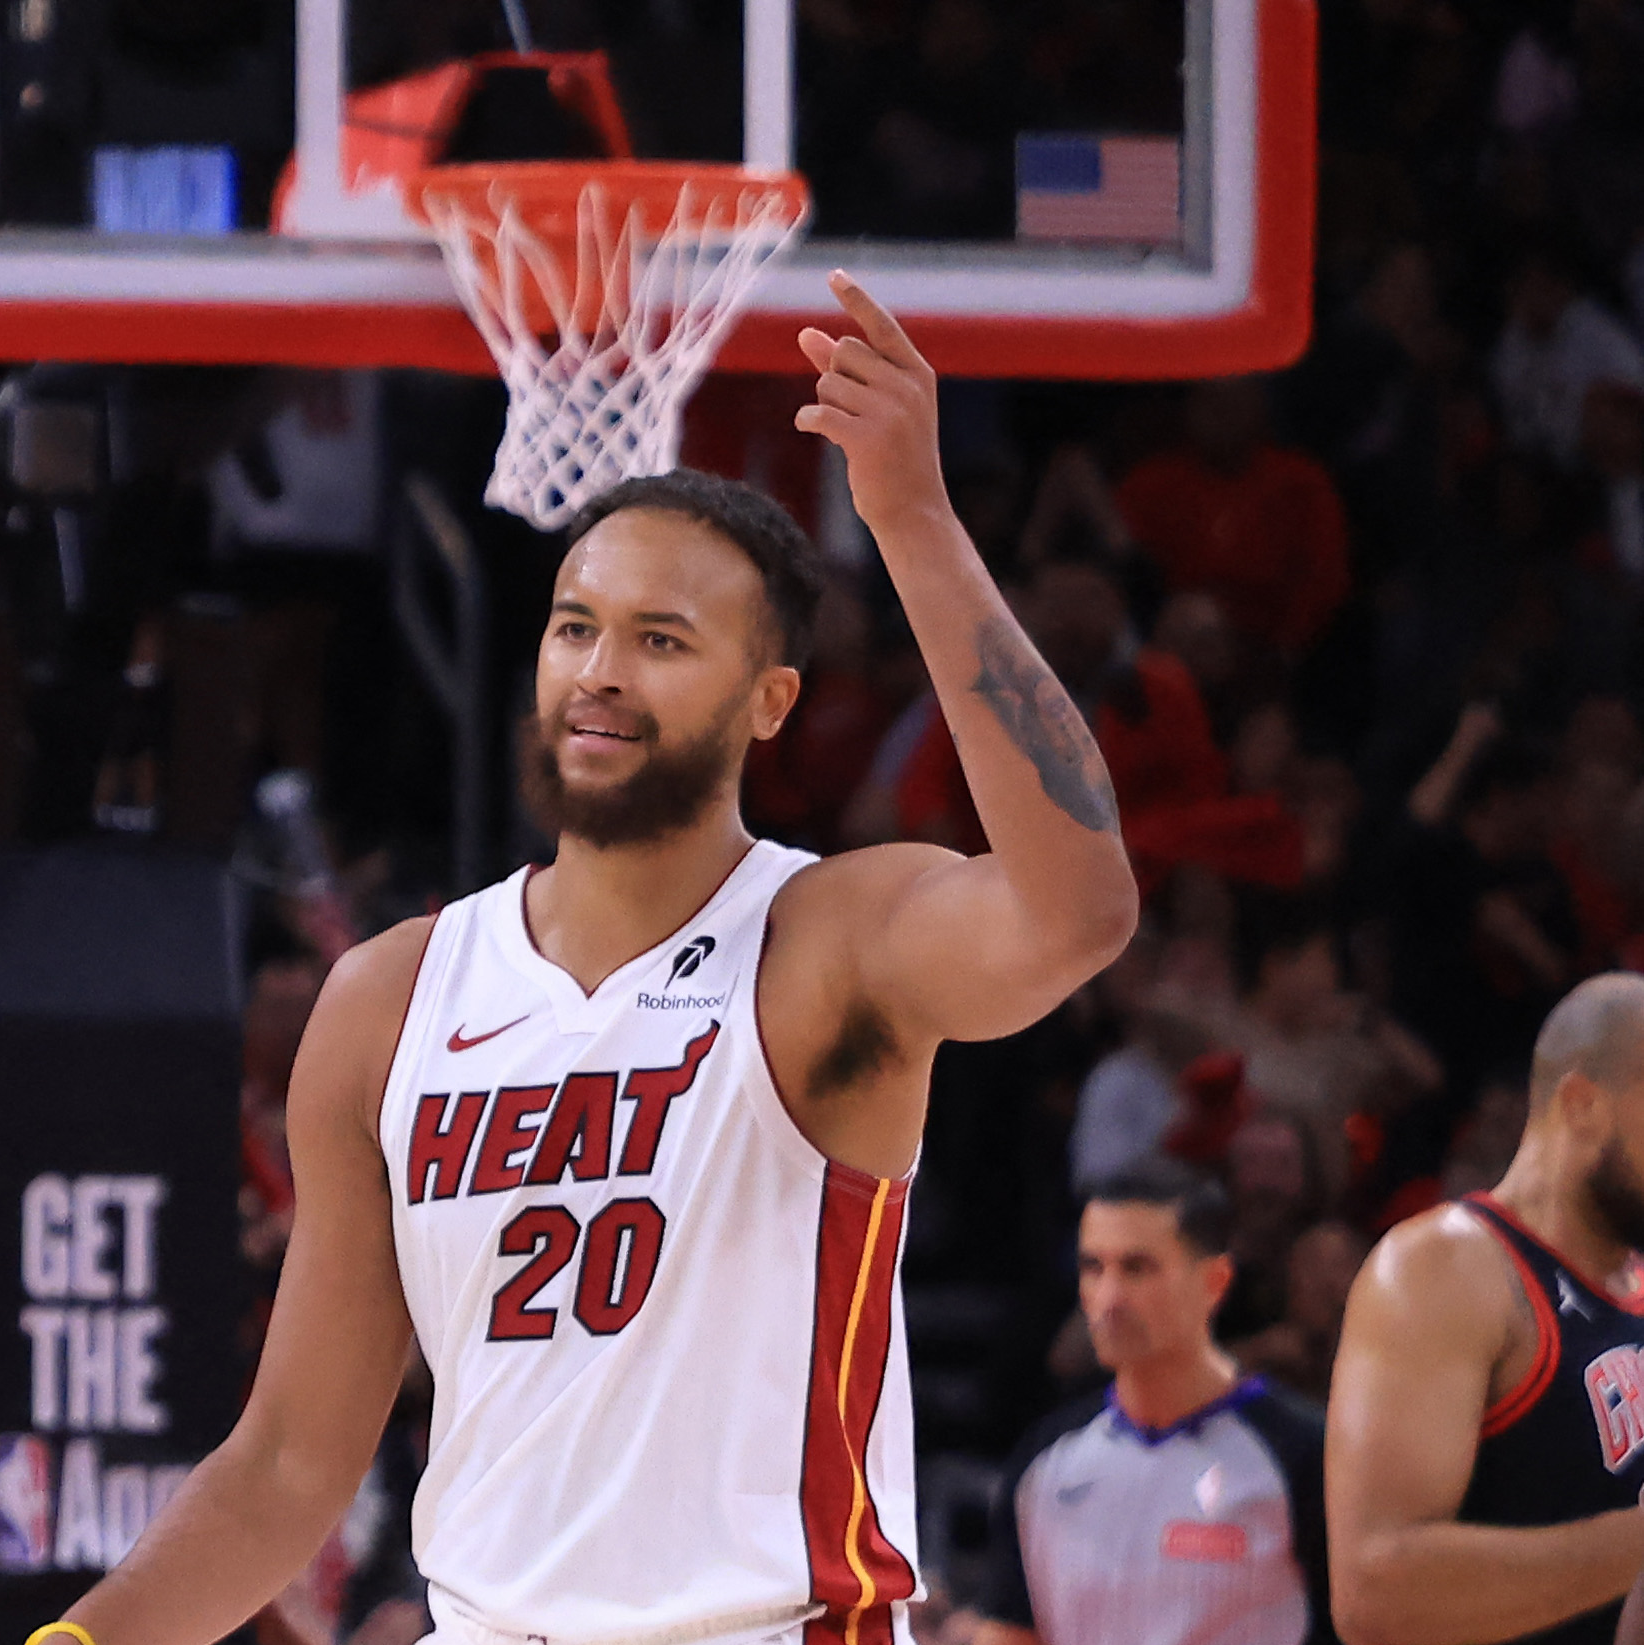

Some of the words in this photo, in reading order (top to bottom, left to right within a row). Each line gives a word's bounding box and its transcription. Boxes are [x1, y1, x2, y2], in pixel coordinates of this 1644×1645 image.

[636, 991, 727, 1011] Robinhood
[406, 1018, 721, 1207] HEAT
[22, 1173, 164, 1298] GET
[484, 1196, 667, 1343] 20
[20, 1307, 167, 1431] THE
